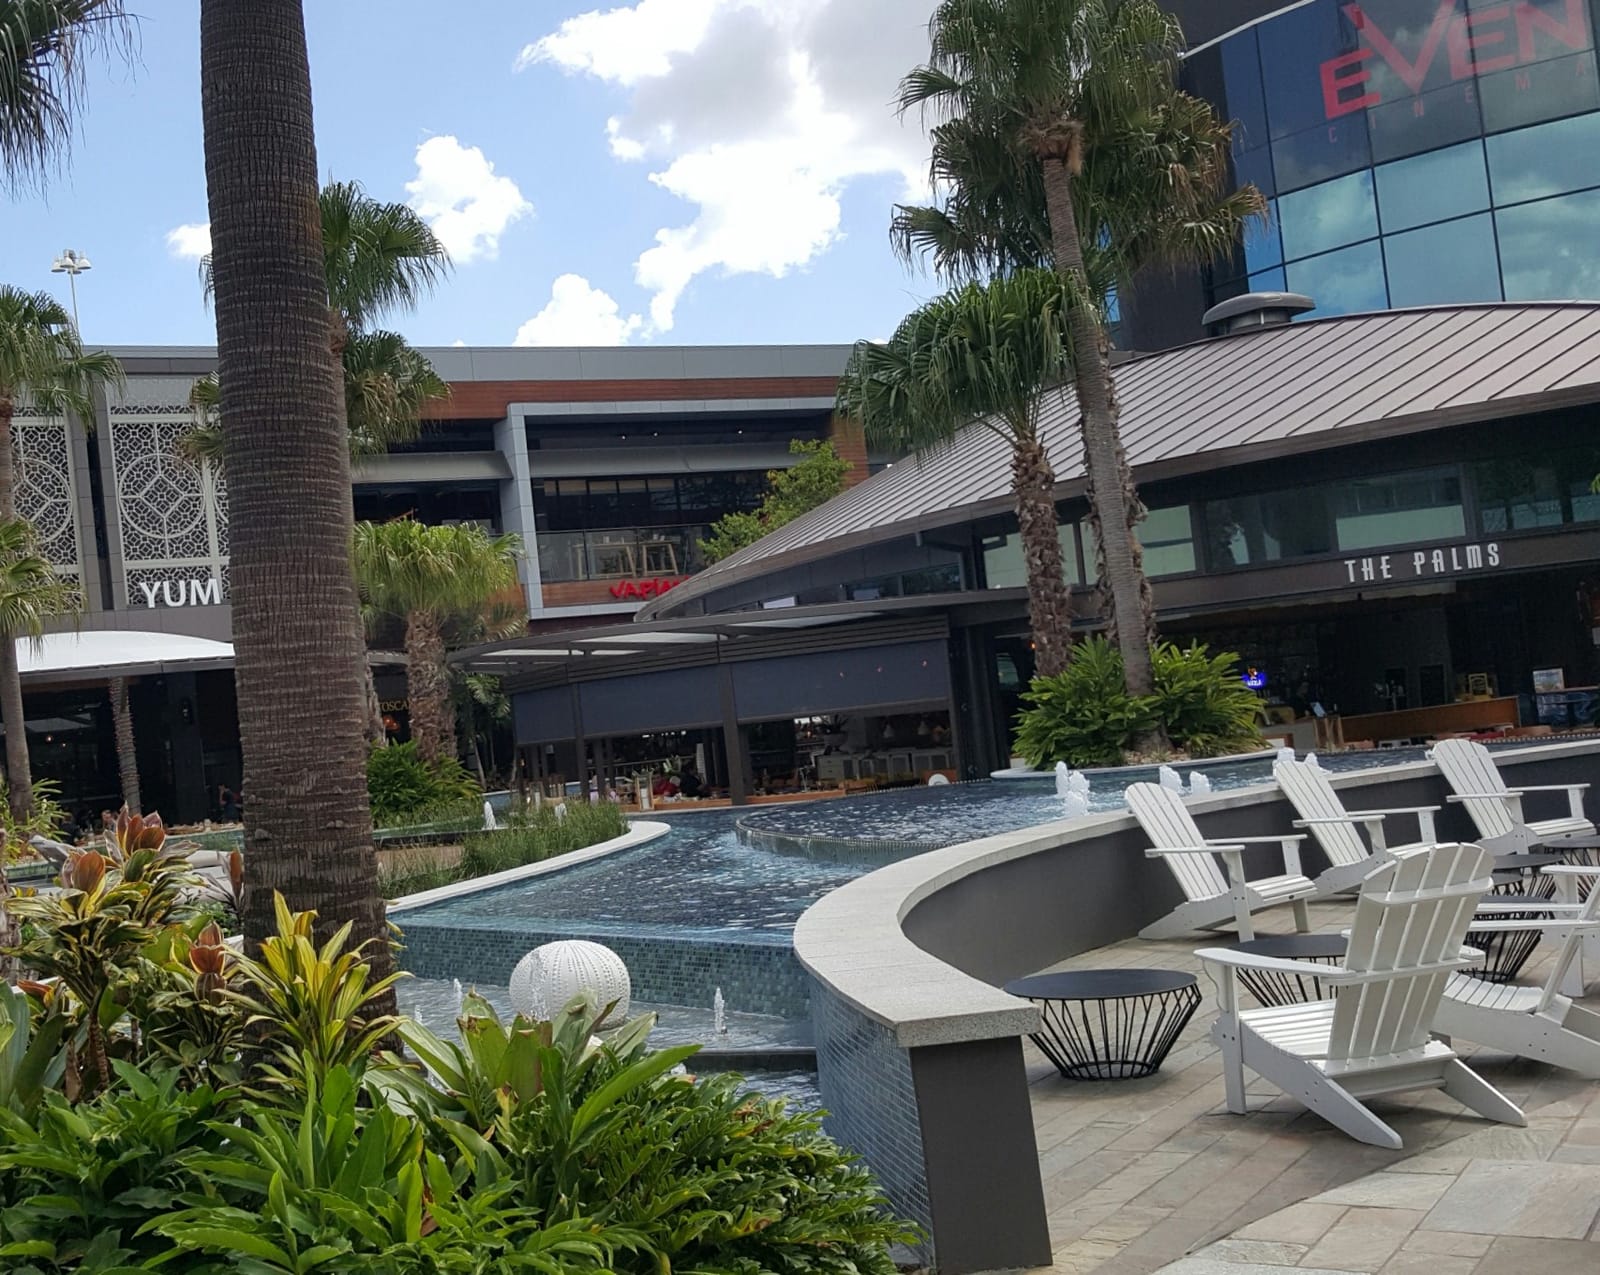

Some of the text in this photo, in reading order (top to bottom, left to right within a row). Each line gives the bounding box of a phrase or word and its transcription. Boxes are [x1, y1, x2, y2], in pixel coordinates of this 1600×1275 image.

[1328, 61, 1585, 143] CINEMA
[1344, 543, 1500, 583] THE PALMS
[140, 578, 221, 608] YUM
